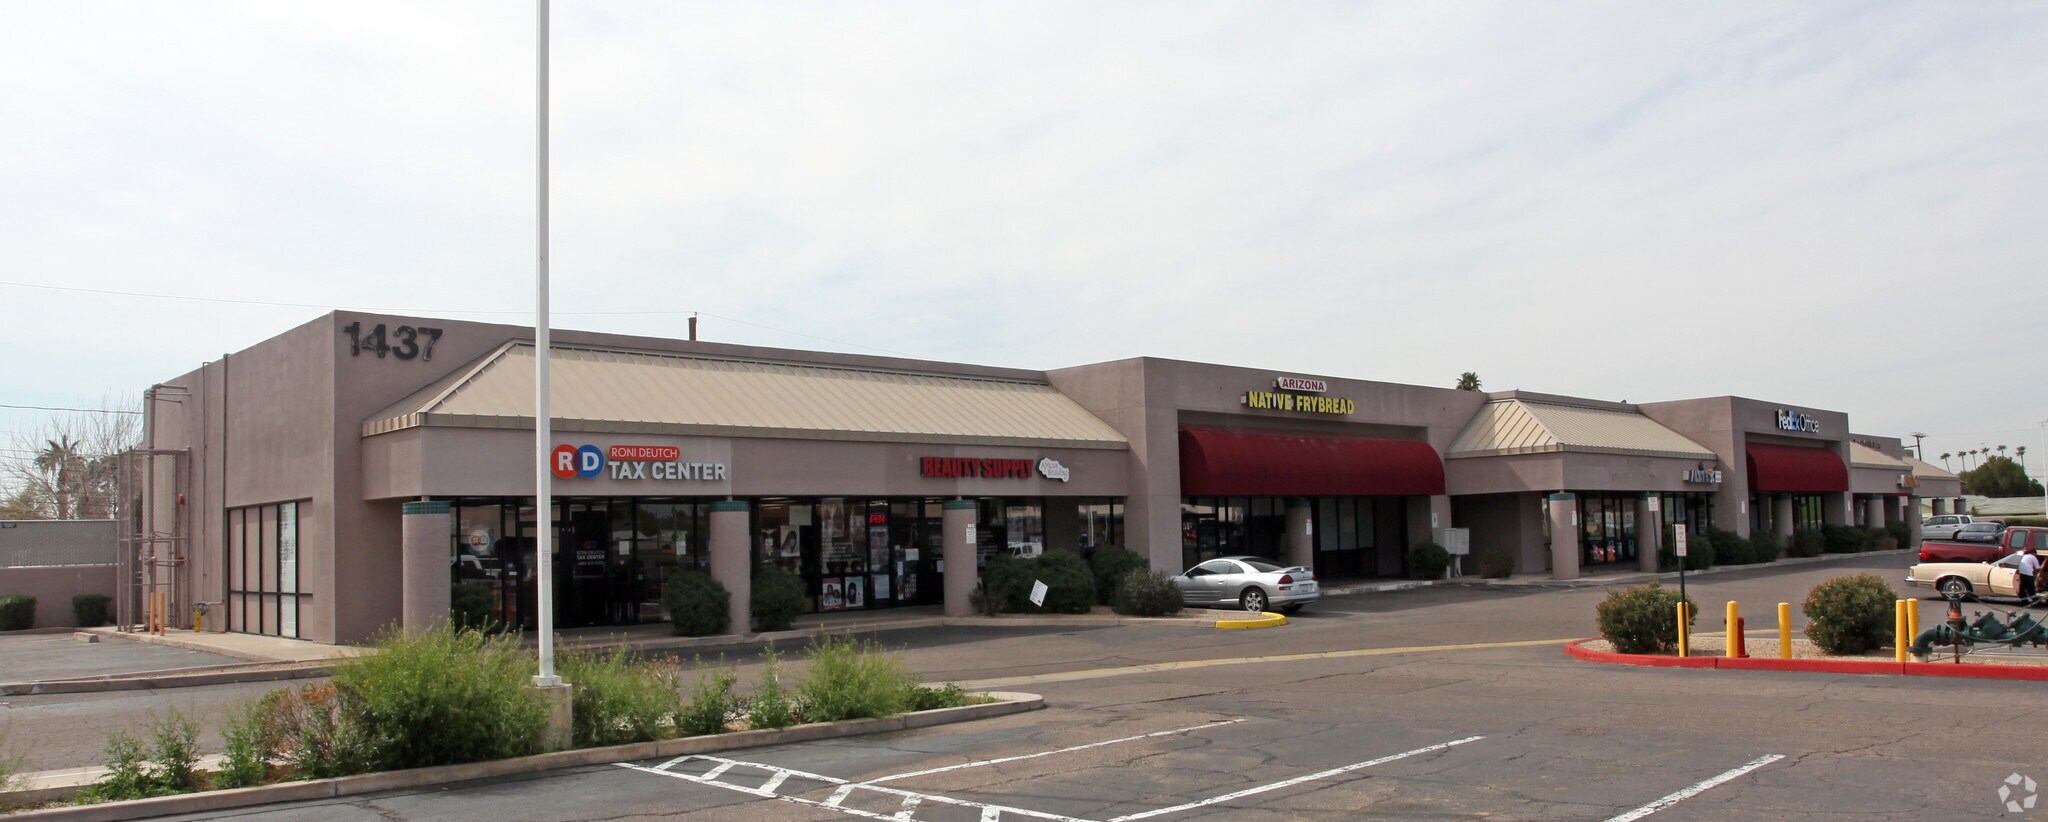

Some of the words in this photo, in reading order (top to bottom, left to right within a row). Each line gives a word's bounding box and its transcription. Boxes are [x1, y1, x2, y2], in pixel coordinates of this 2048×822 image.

[343, 321, 443, 361] 1437
[1281, 379, 1325, 391] ARIZONA
[1248, 391, 1293, 411] NATIVE
[1296, 395, 1355, 415] FRYBREAD
[611, 447, 637, 458] RONI
[638, 448, 678, 458] DEUTCH
[608, 461, 646, 480] TAX
[652, 462, 726, 480] CENTER
[921, 457, 981, 478] BEAUTY
[982, 458, 1034, 478] SUPPLY
